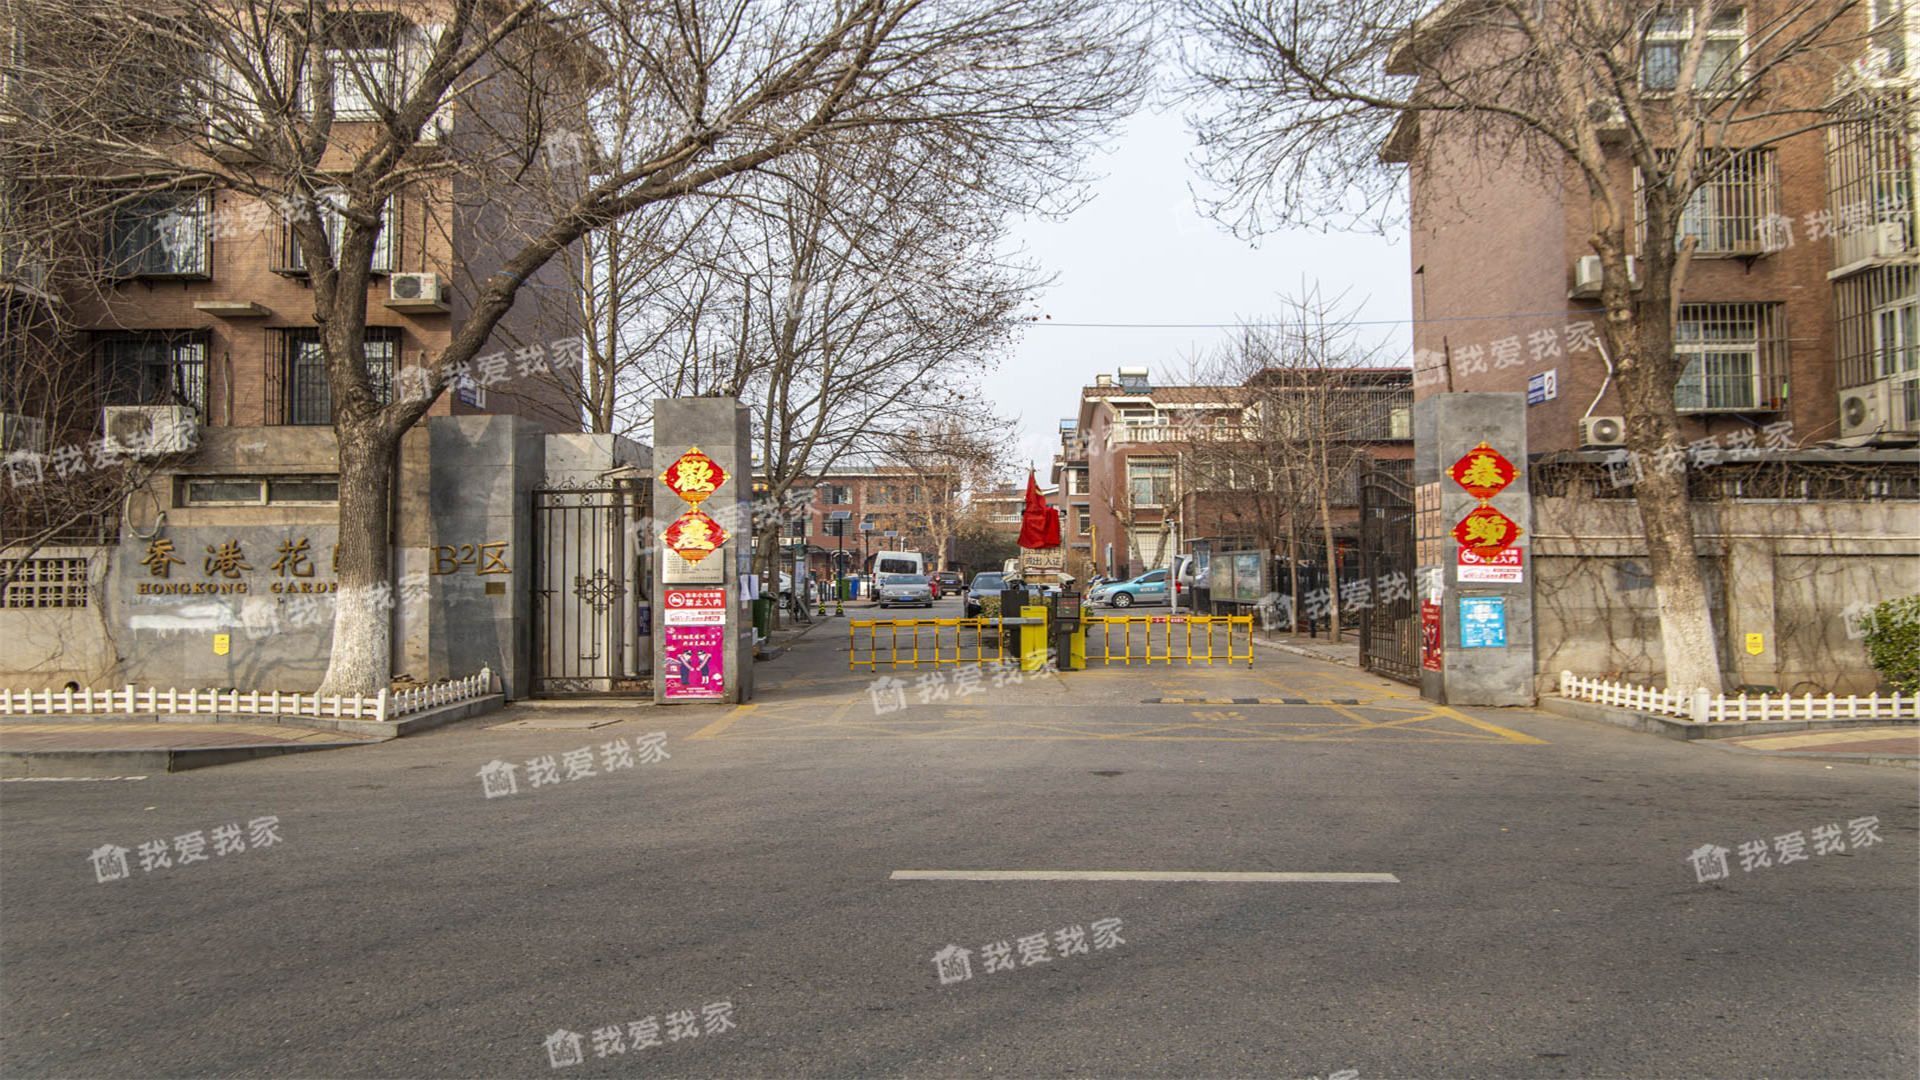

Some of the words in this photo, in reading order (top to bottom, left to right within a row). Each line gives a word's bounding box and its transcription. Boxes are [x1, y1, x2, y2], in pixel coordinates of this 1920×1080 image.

[1546, 375, 1554, 395] 2
[1460, 455, 1505, 487] 春
[140, 536, 339, 578] 香港花
[137, 583, 248, 595] HONGKONG
